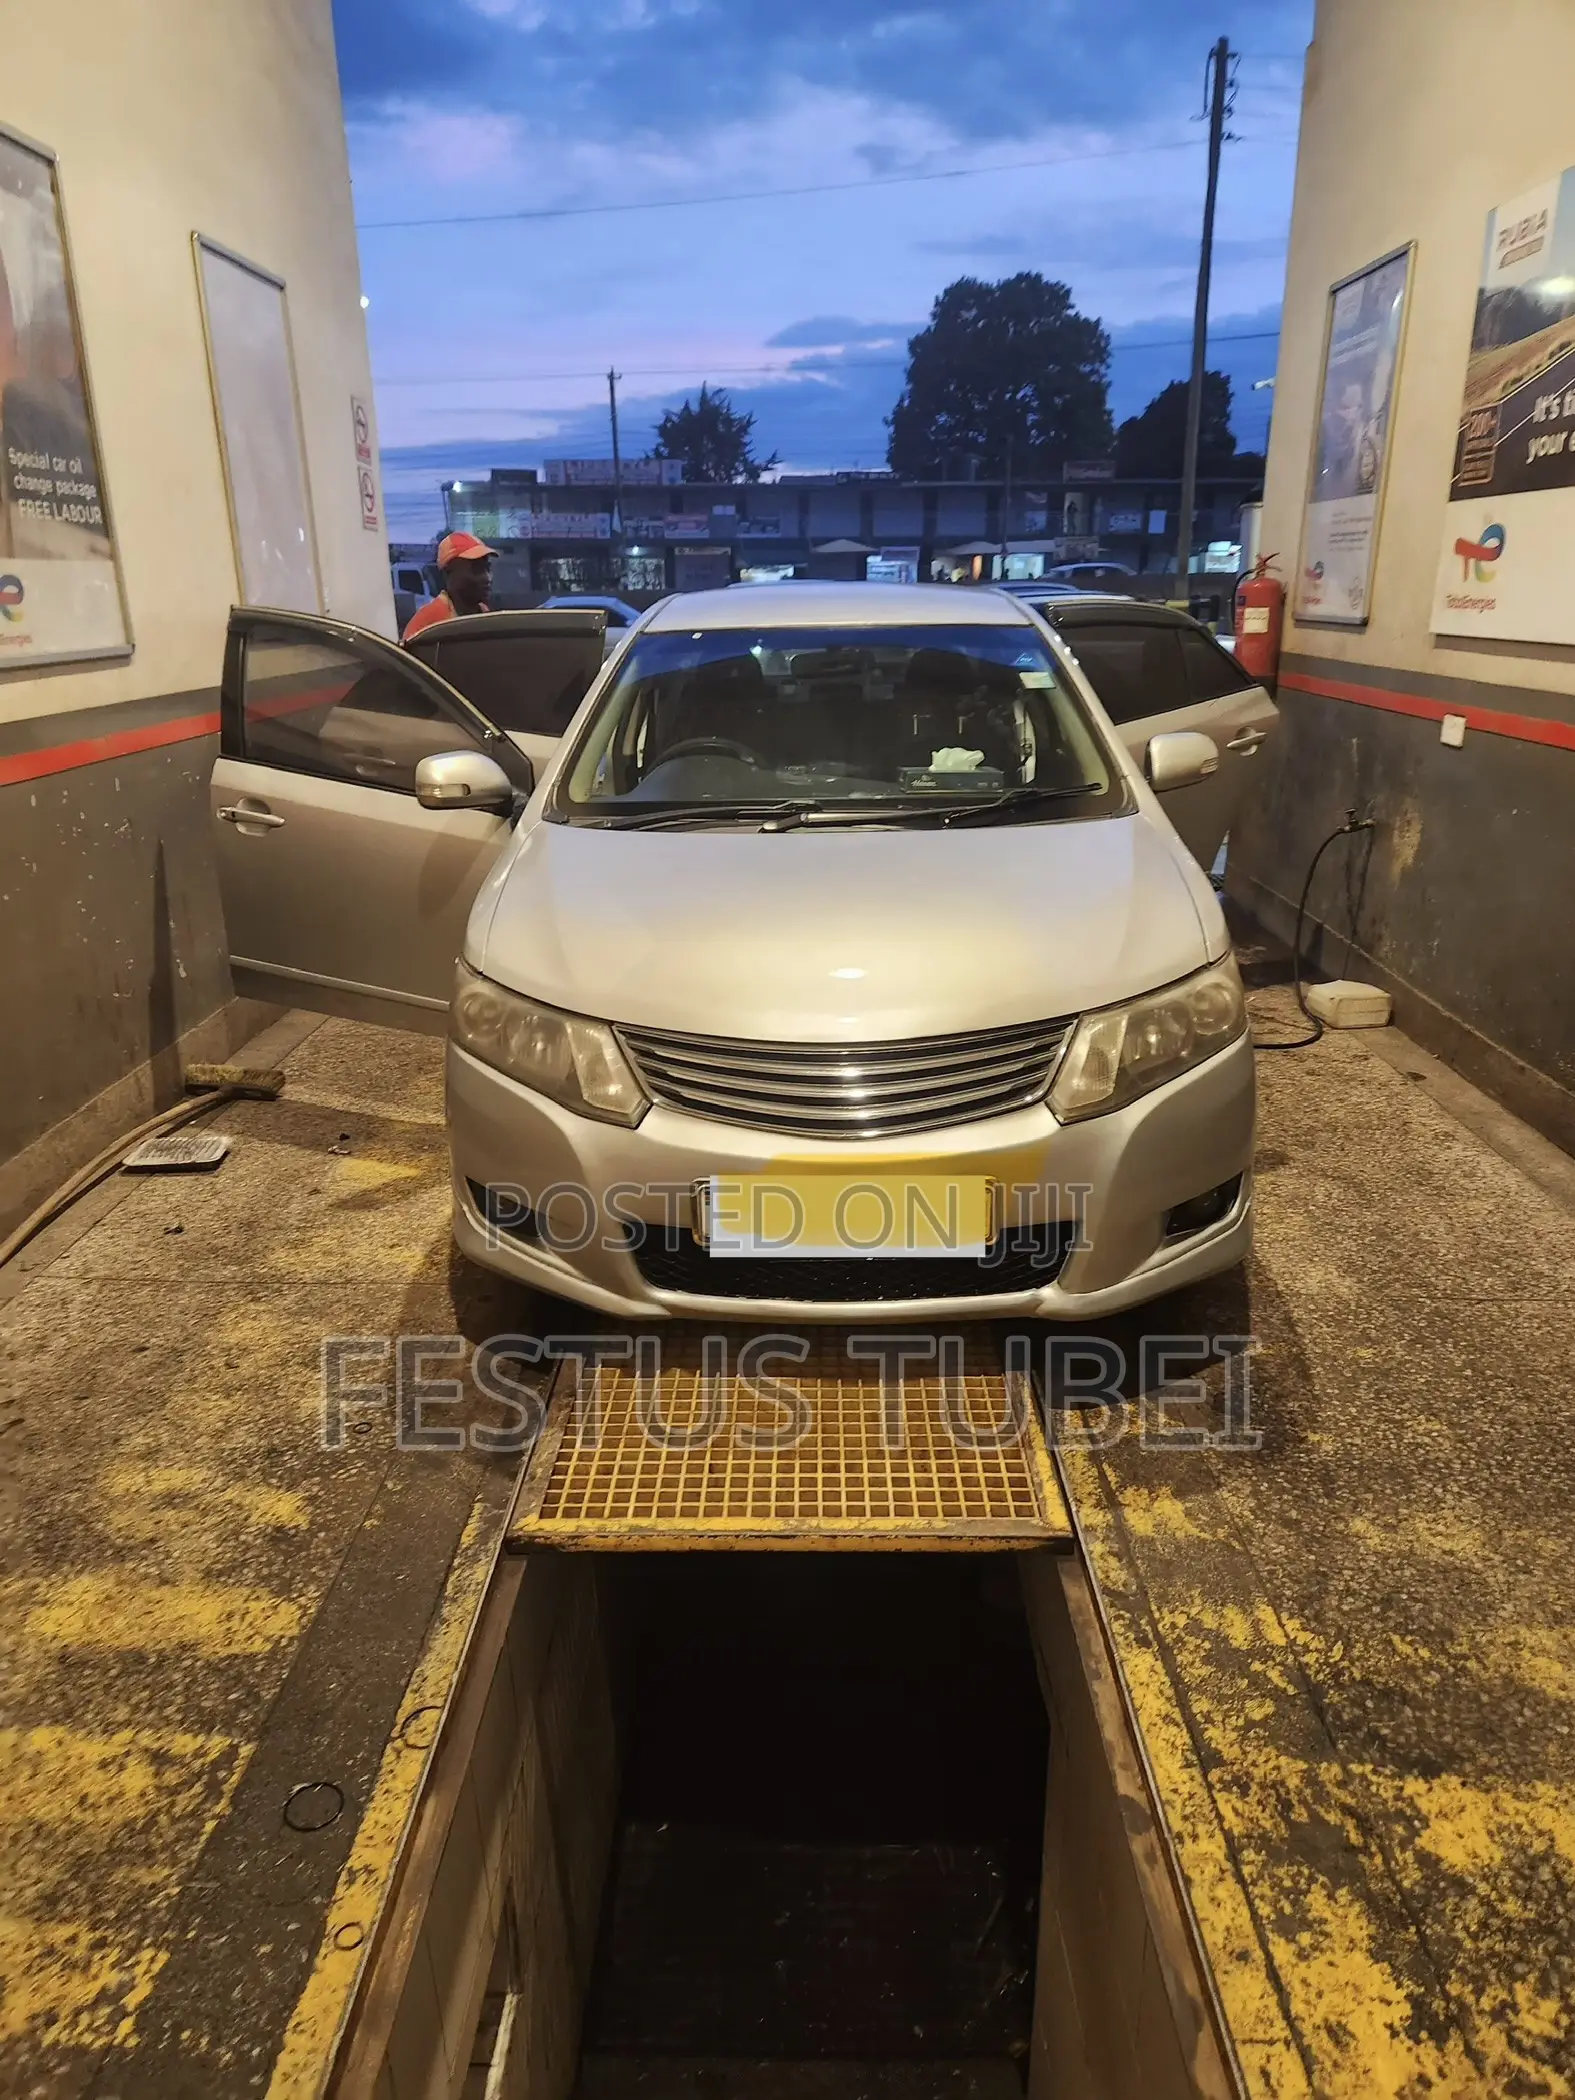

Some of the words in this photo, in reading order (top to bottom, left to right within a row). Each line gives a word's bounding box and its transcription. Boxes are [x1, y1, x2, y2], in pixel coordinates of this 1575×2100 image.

[8, 447, 49, 471] Special
[52, 457, 66, 473] car
[69, 457, 83, 475] oil
[1526, 431, 1568, 465] your
[13, 473, 53, 494] change
[56, 479, 97, 502] package
[18, 498, 52, 521] FREE
[54, 502, 103, 525] LABOUR
